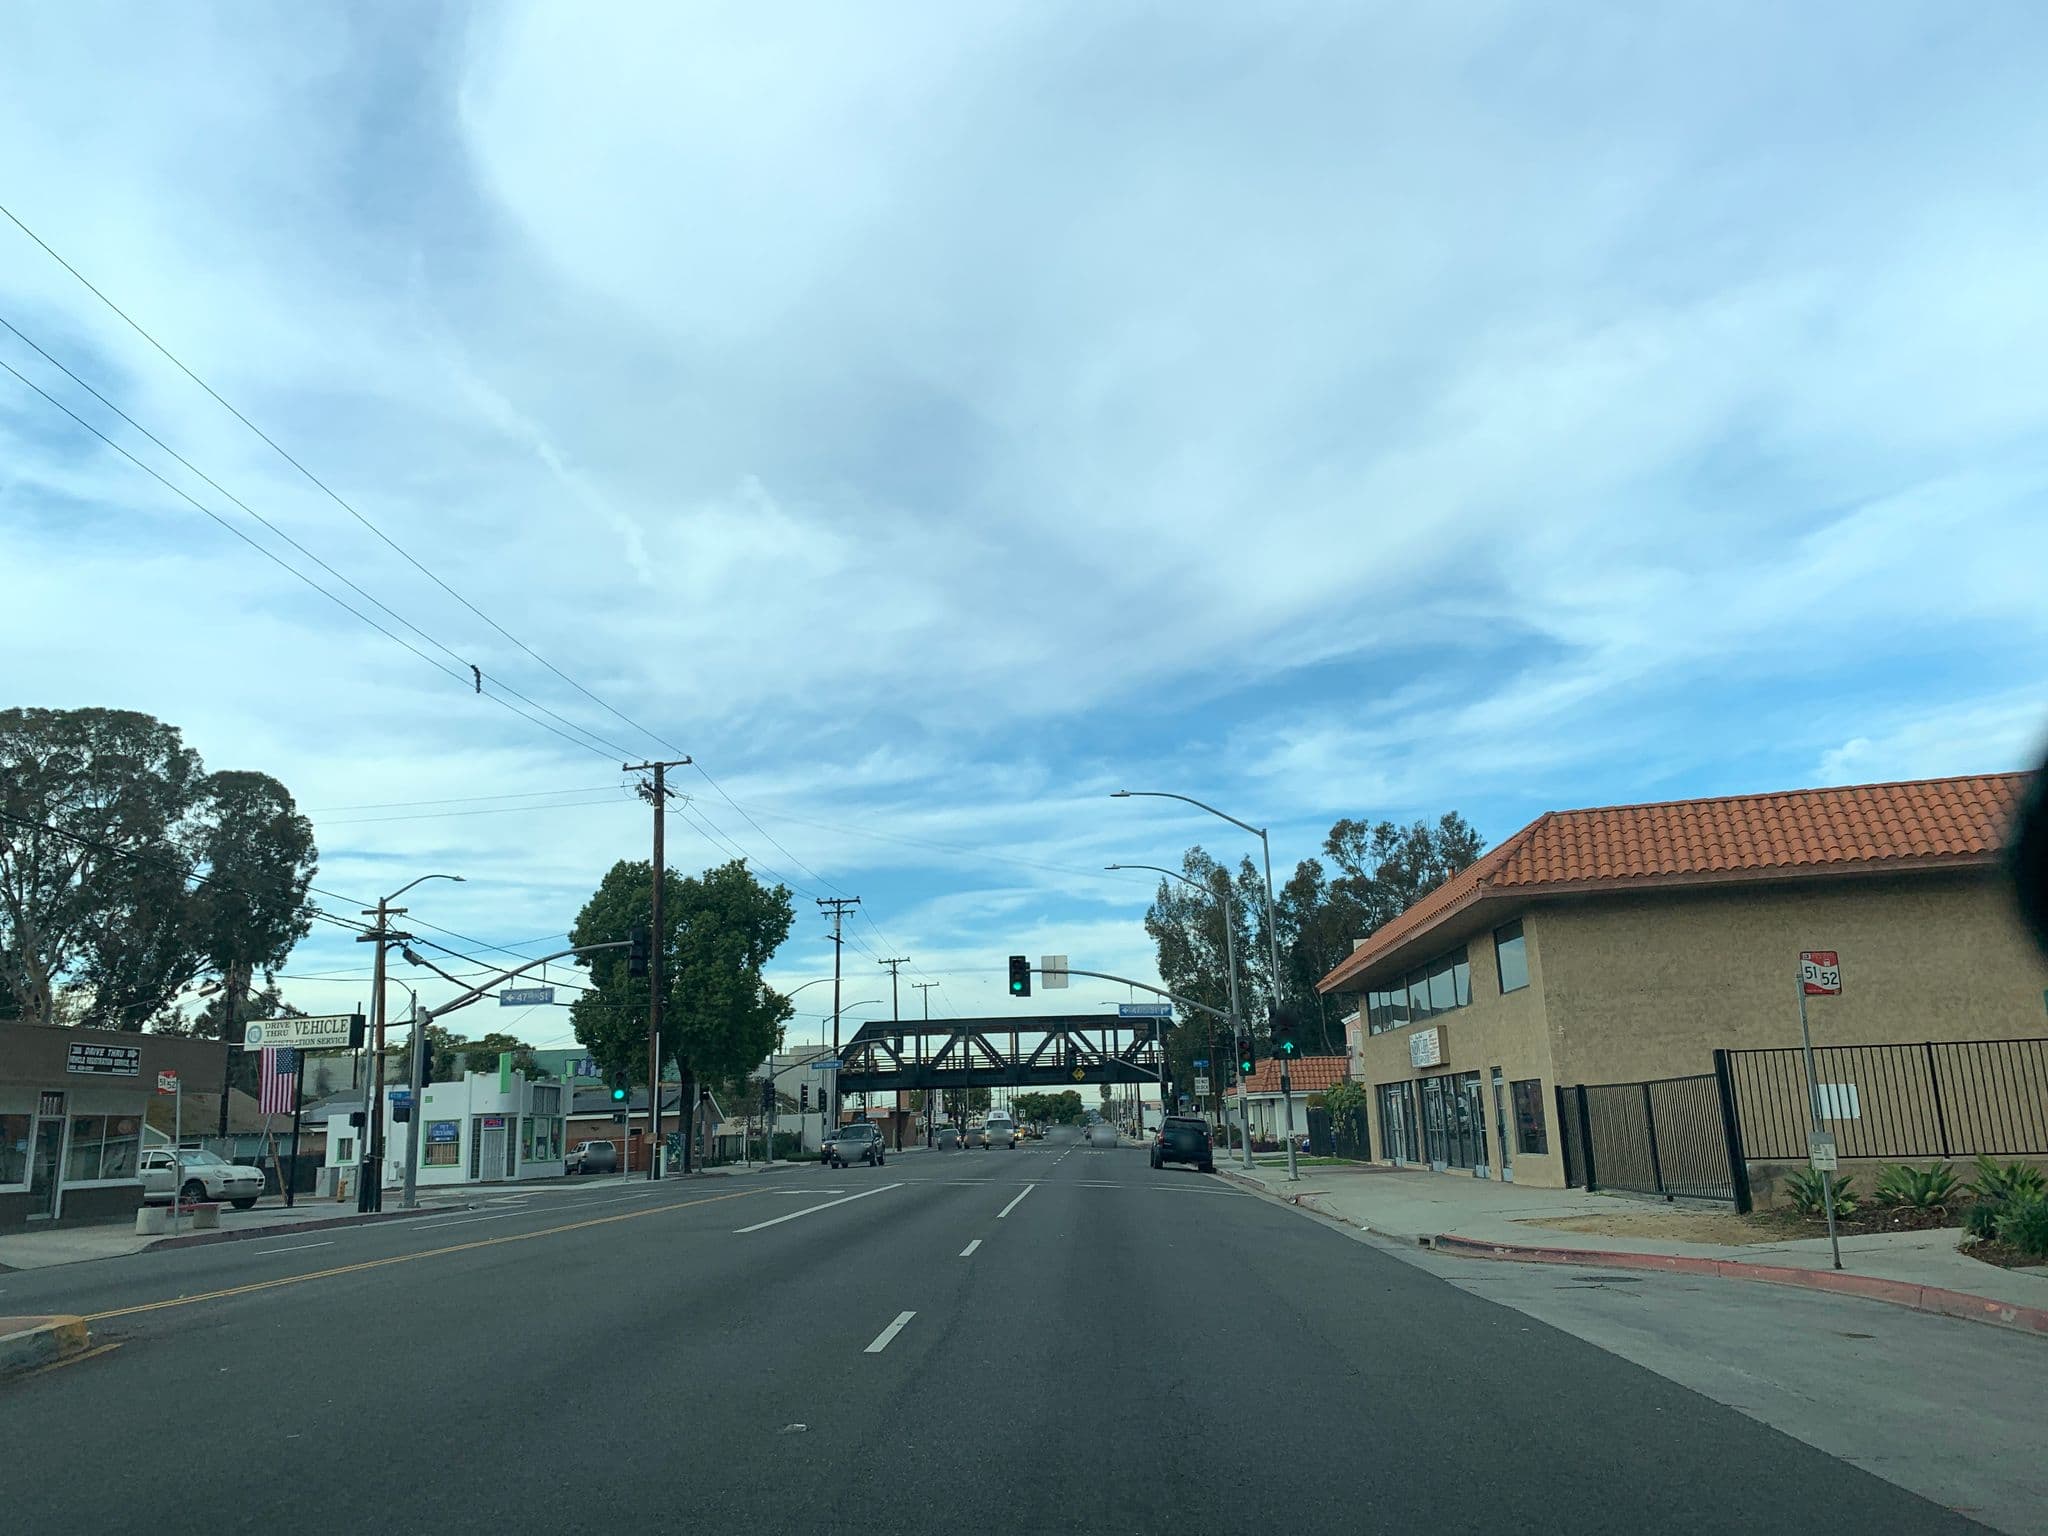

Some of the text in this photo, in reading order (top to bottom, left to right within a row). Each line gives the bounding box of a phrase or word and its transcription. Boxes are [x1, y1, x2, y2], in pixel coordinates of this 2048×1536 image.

[1805, 966, 1839, 986] 51 52
[265, 1019, 348, 1036] DRIVE VEHICLE
[265, 1029, 290, 1038] THRU
[317, 1036, 348, 1046] SERVICE
[84, 1046, 125, 1058] DRIVE THRU
[159, 1078, 177, 1090] 51 52
